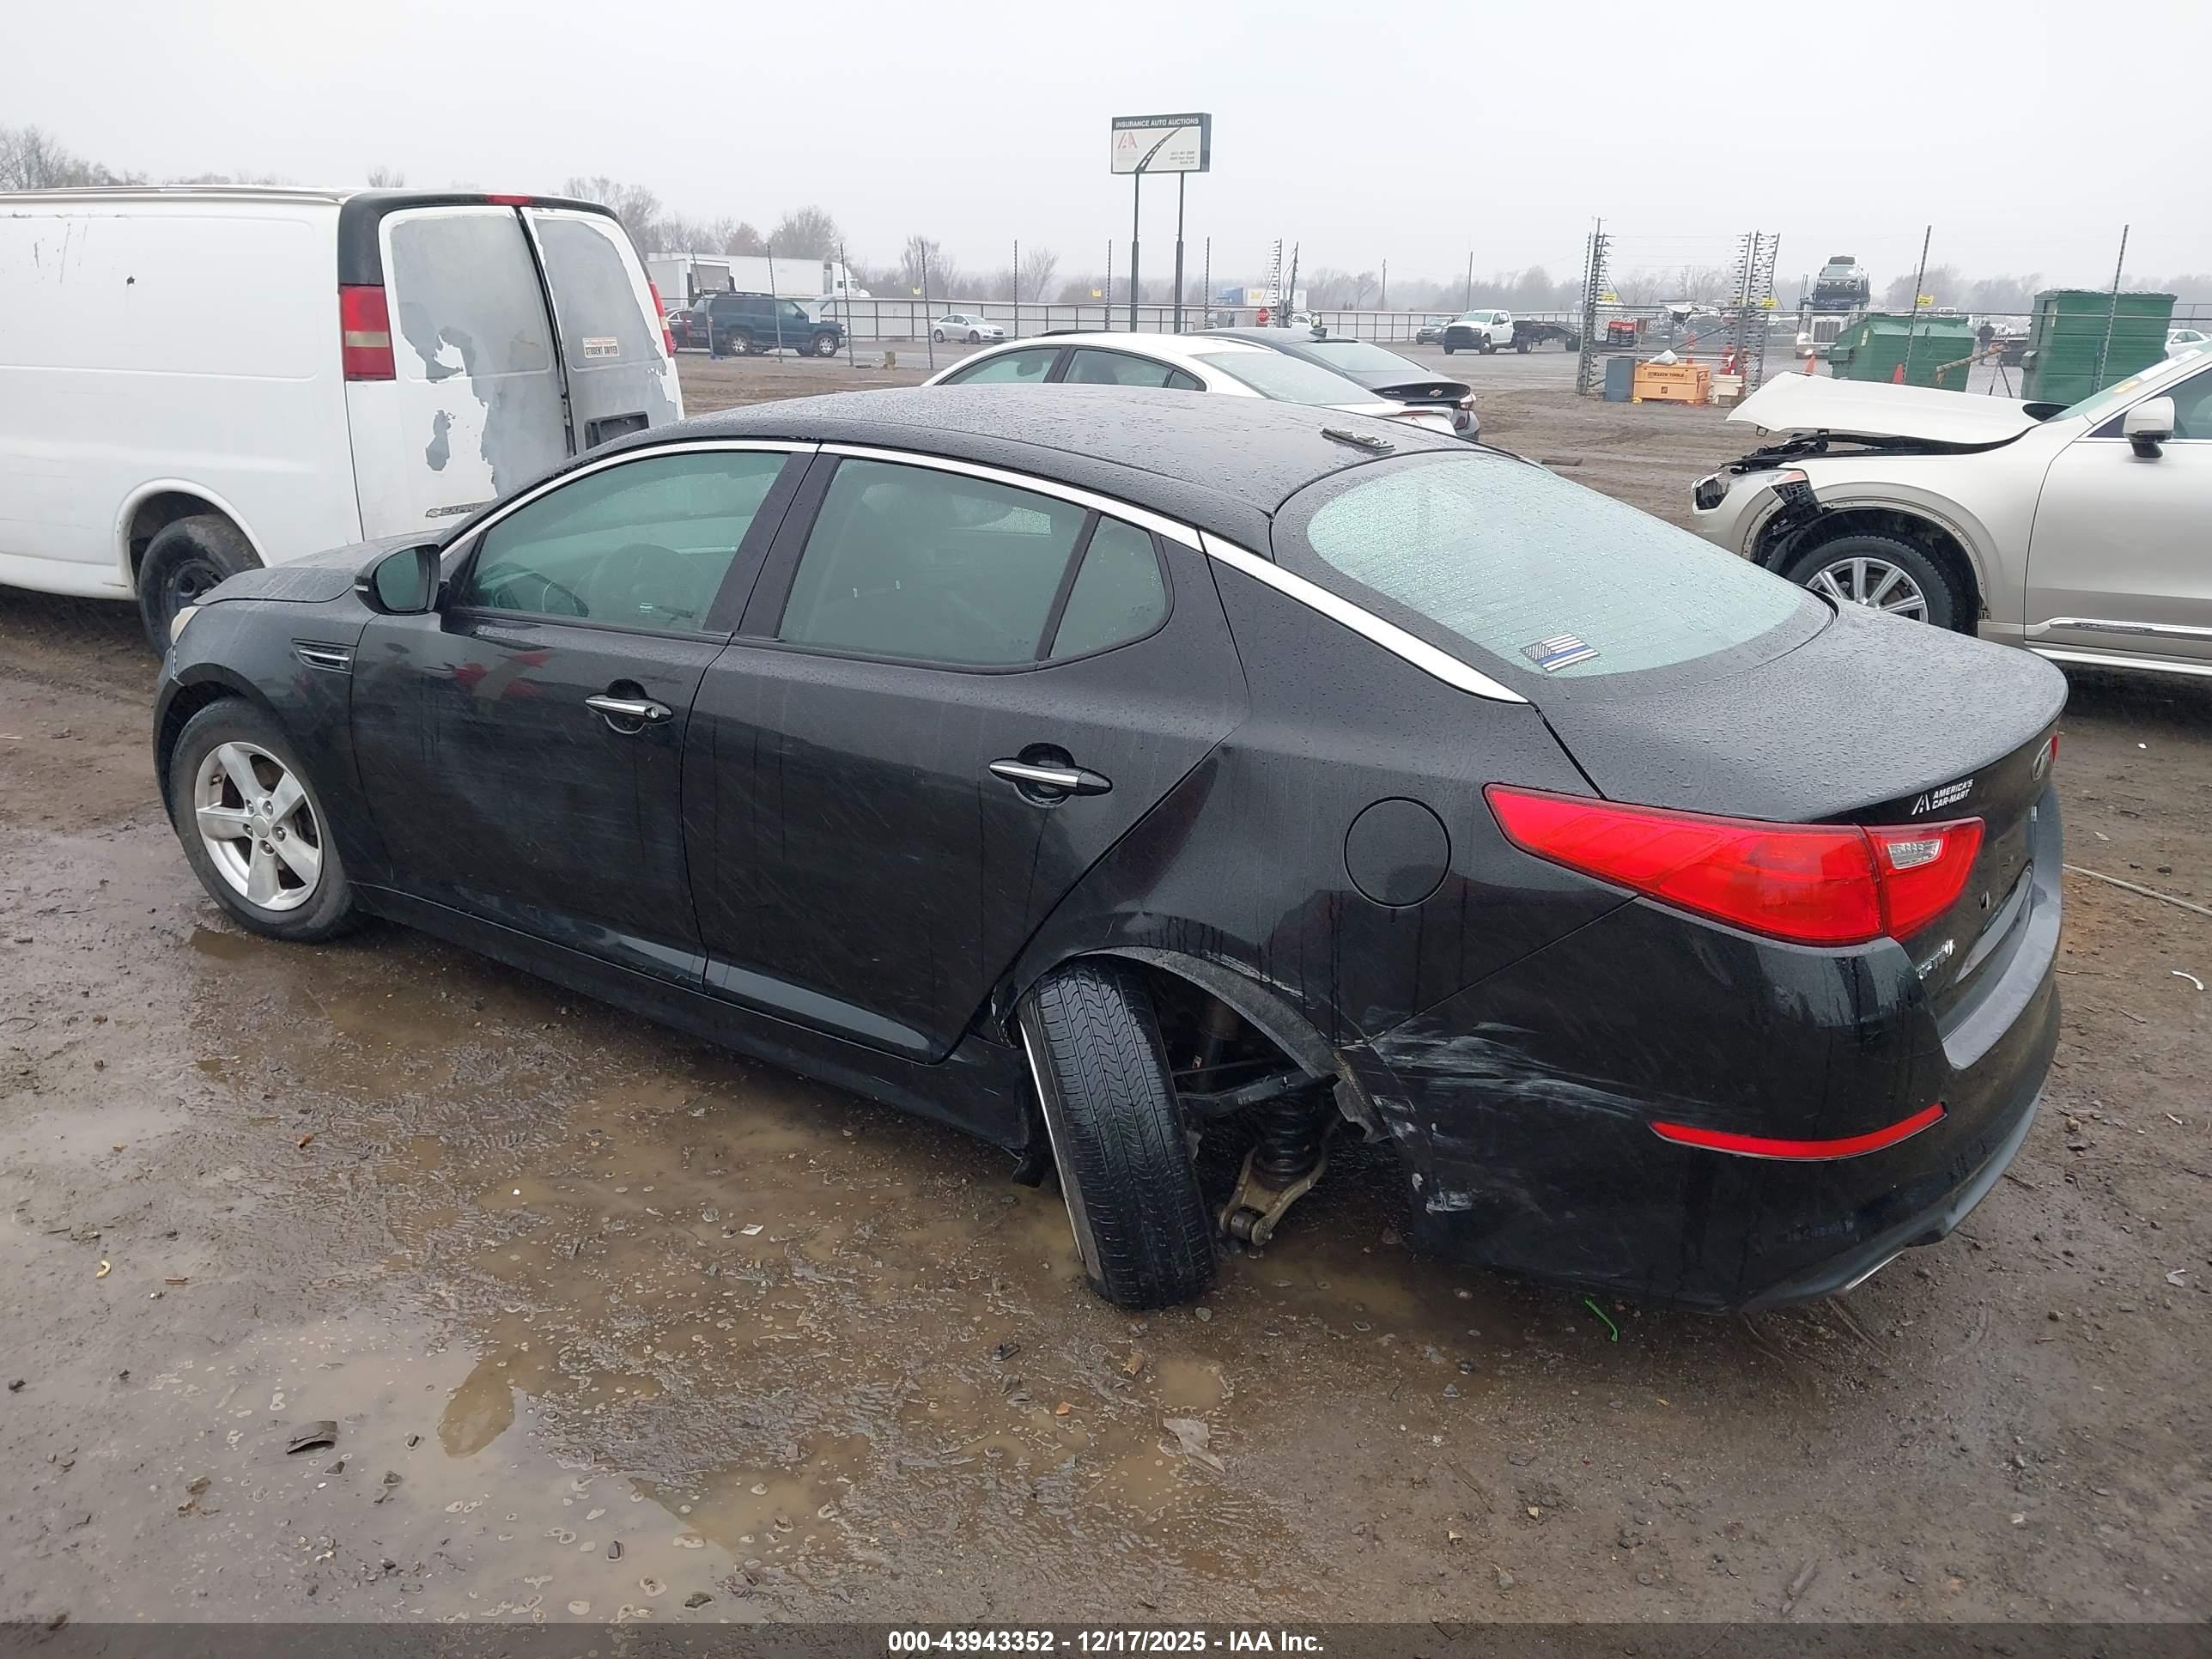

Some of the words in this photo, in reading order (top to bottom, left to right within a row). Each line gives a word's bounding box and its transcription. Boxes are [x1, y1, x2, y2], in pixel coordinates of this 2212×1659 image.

[585, 346, 602, 356] STUDENT
[604, 345, 618, 356] DRIVER
[1932, 779, 1974, 800] AMERICA'S
